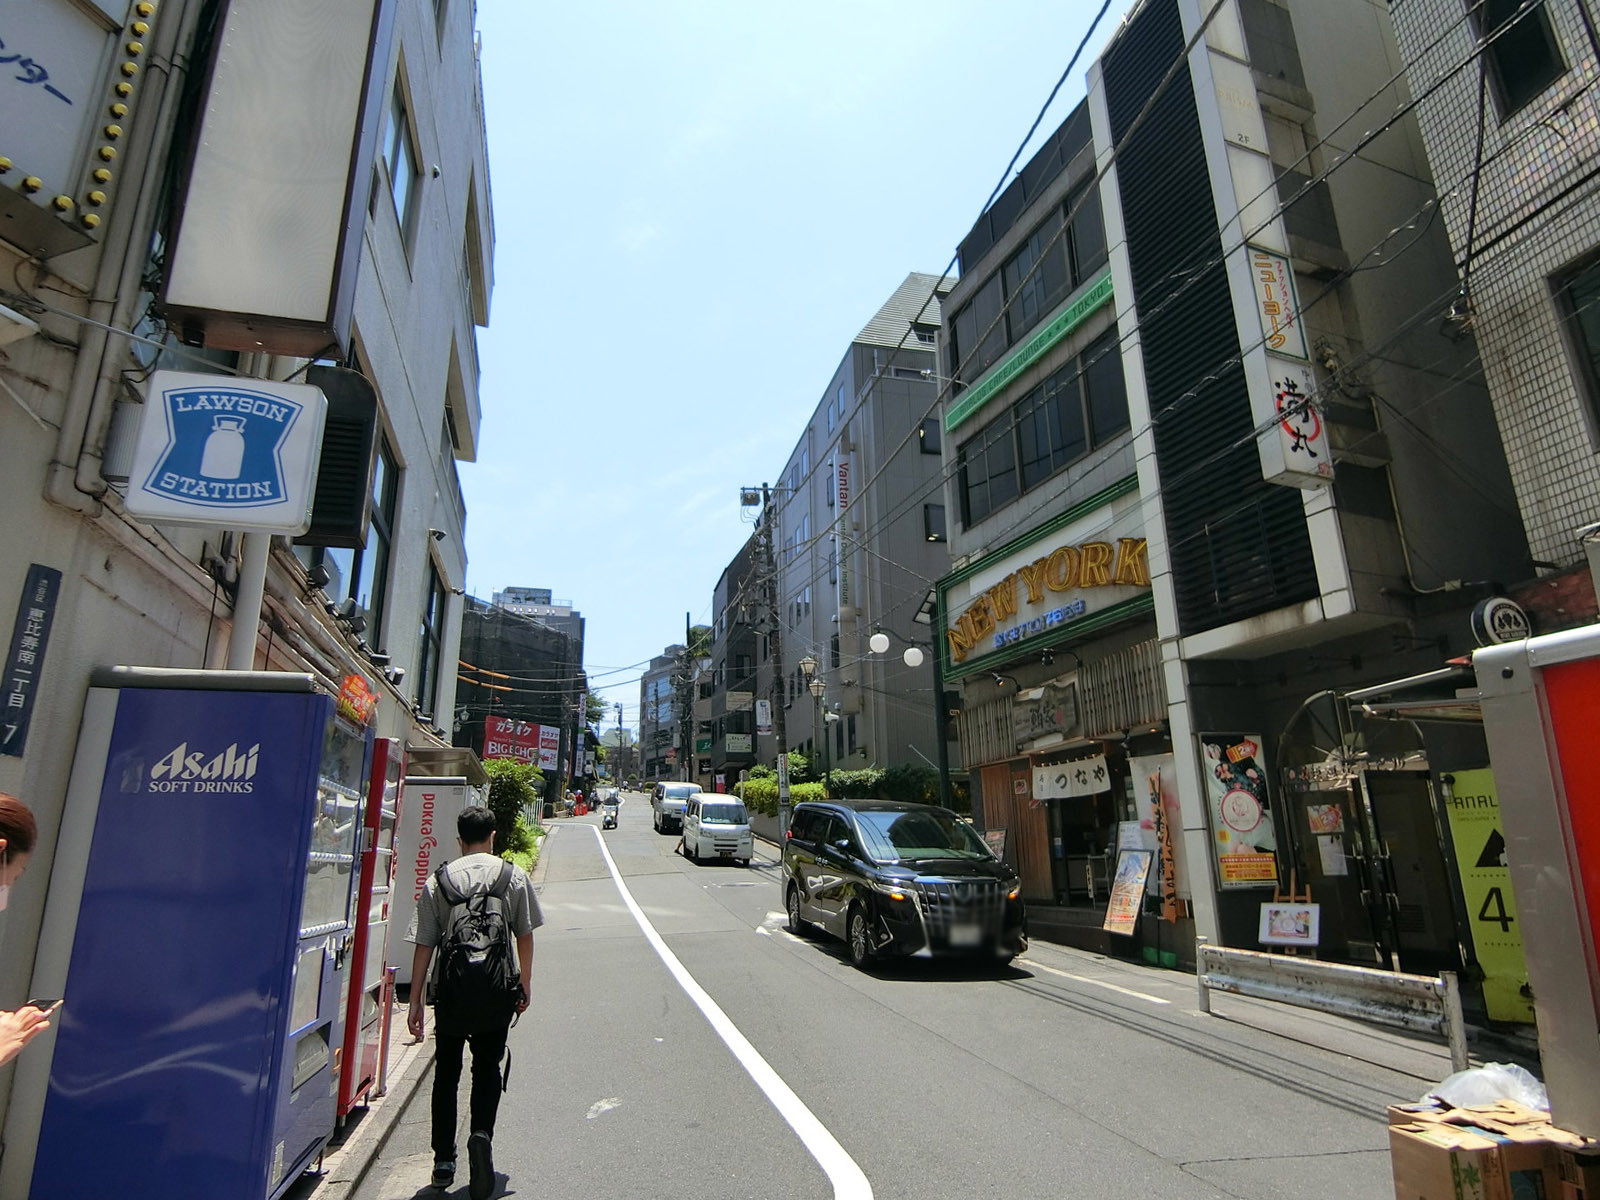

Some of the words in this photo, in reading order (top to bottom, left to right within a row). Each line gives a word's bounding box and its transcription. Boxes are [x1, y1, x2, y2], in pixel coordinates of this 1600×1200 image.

[1238, 133, 1250, 144] 2F
[1072, 285, 1105, 319] TOKYO
[1255, 254, 1286, 348] ニューヨーク
[176, 394, 289, 424] LAWSON
[160, 471, 273, 499] STATION
[838, 462, 849, 509] Vantan
[841, 570, 849, 604] Institute
[946, 573, 1019, 663] NEW
[1019, 537, 1152, 605] YORK
[7, 607, 46, 709] 恵比寿南一丁目
[3, 724, 18, 744] 7
[495, 719, 533, 737] カラオケ
[149, 742, 261, 781] Asahi
[488, 741, 508, 755] BIG
[148, 779, 191, 794] SOFT
[193, 779, 254, 794] DRINKS
[1055, 764, 1105, 789] つなや
[1454, 795, 1499, 810] ANAL
[1478, 887, 1514, 933] 4
